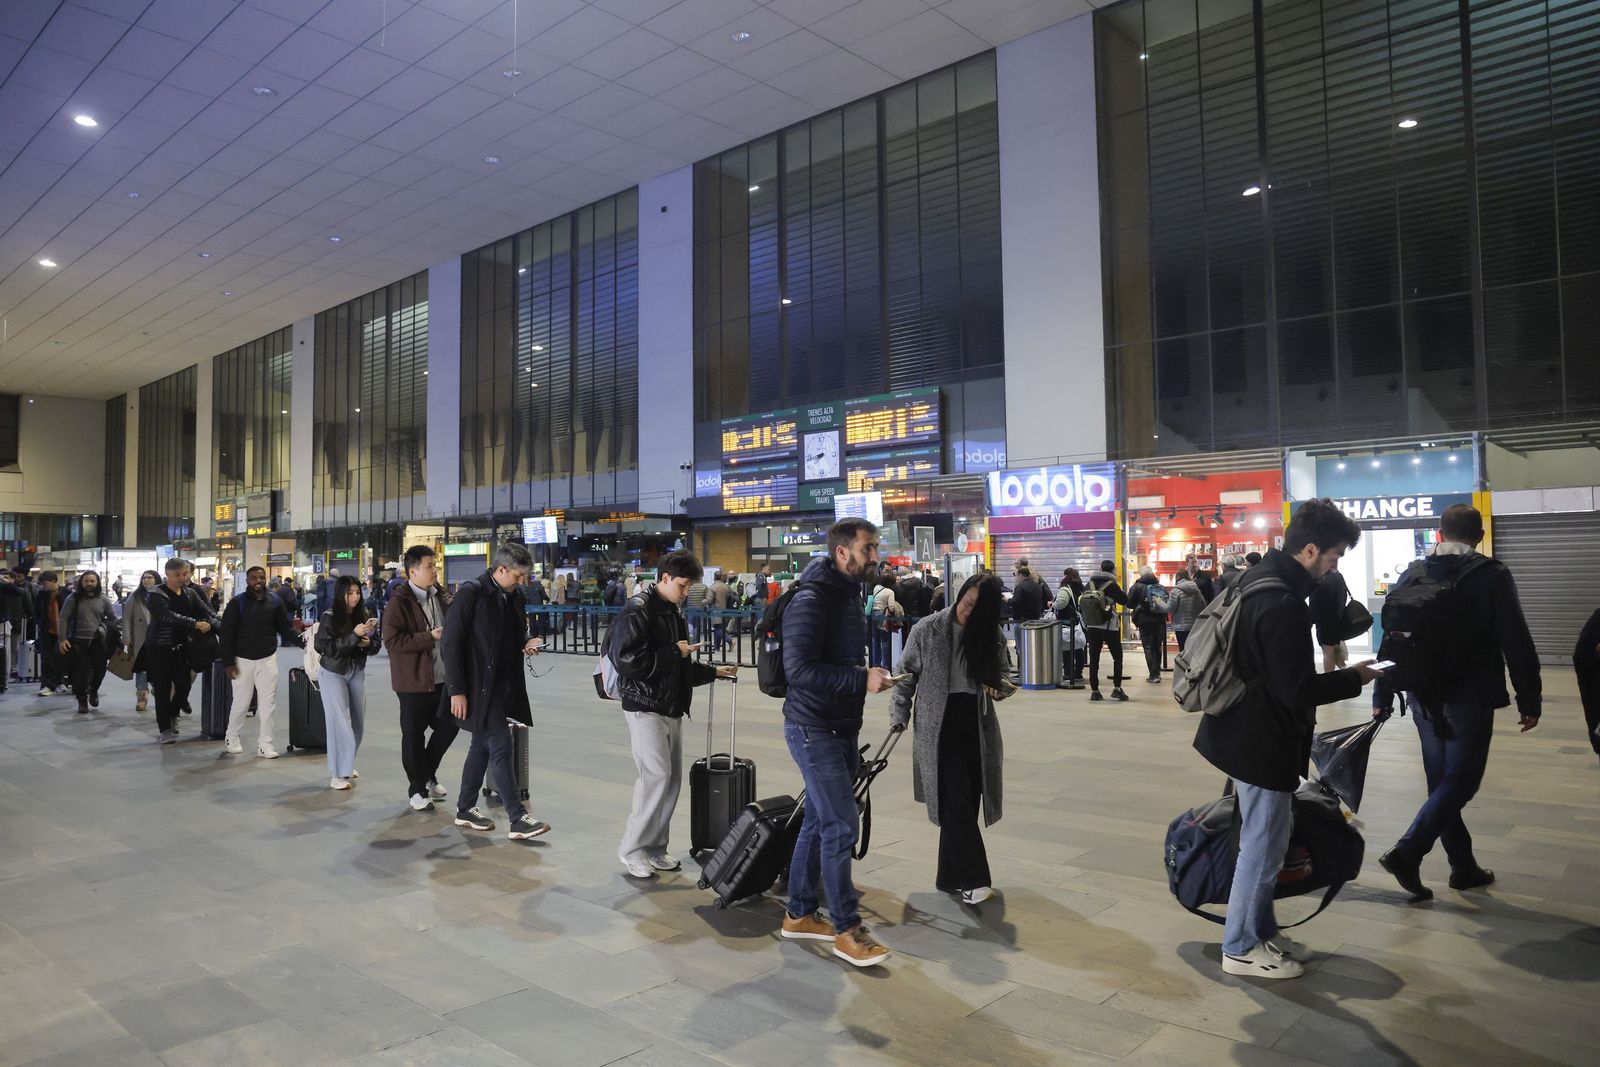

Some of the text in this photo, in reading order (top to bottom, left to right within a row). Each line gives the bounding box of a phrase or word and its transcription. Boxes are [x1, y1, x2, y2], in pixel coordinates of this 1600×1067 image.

[808, 406, 834, 417] TRENES ALTA
[809, 415, 832, 425] VELOCIDAD
[809, 487, 835, 497] HIGH SPEED
[815, 496, 830, 505] TRAINS
[1035, 514, 1062, 530] RELAY
[922, 538, 931, 559] A
[316, 560, 322, 572] B
